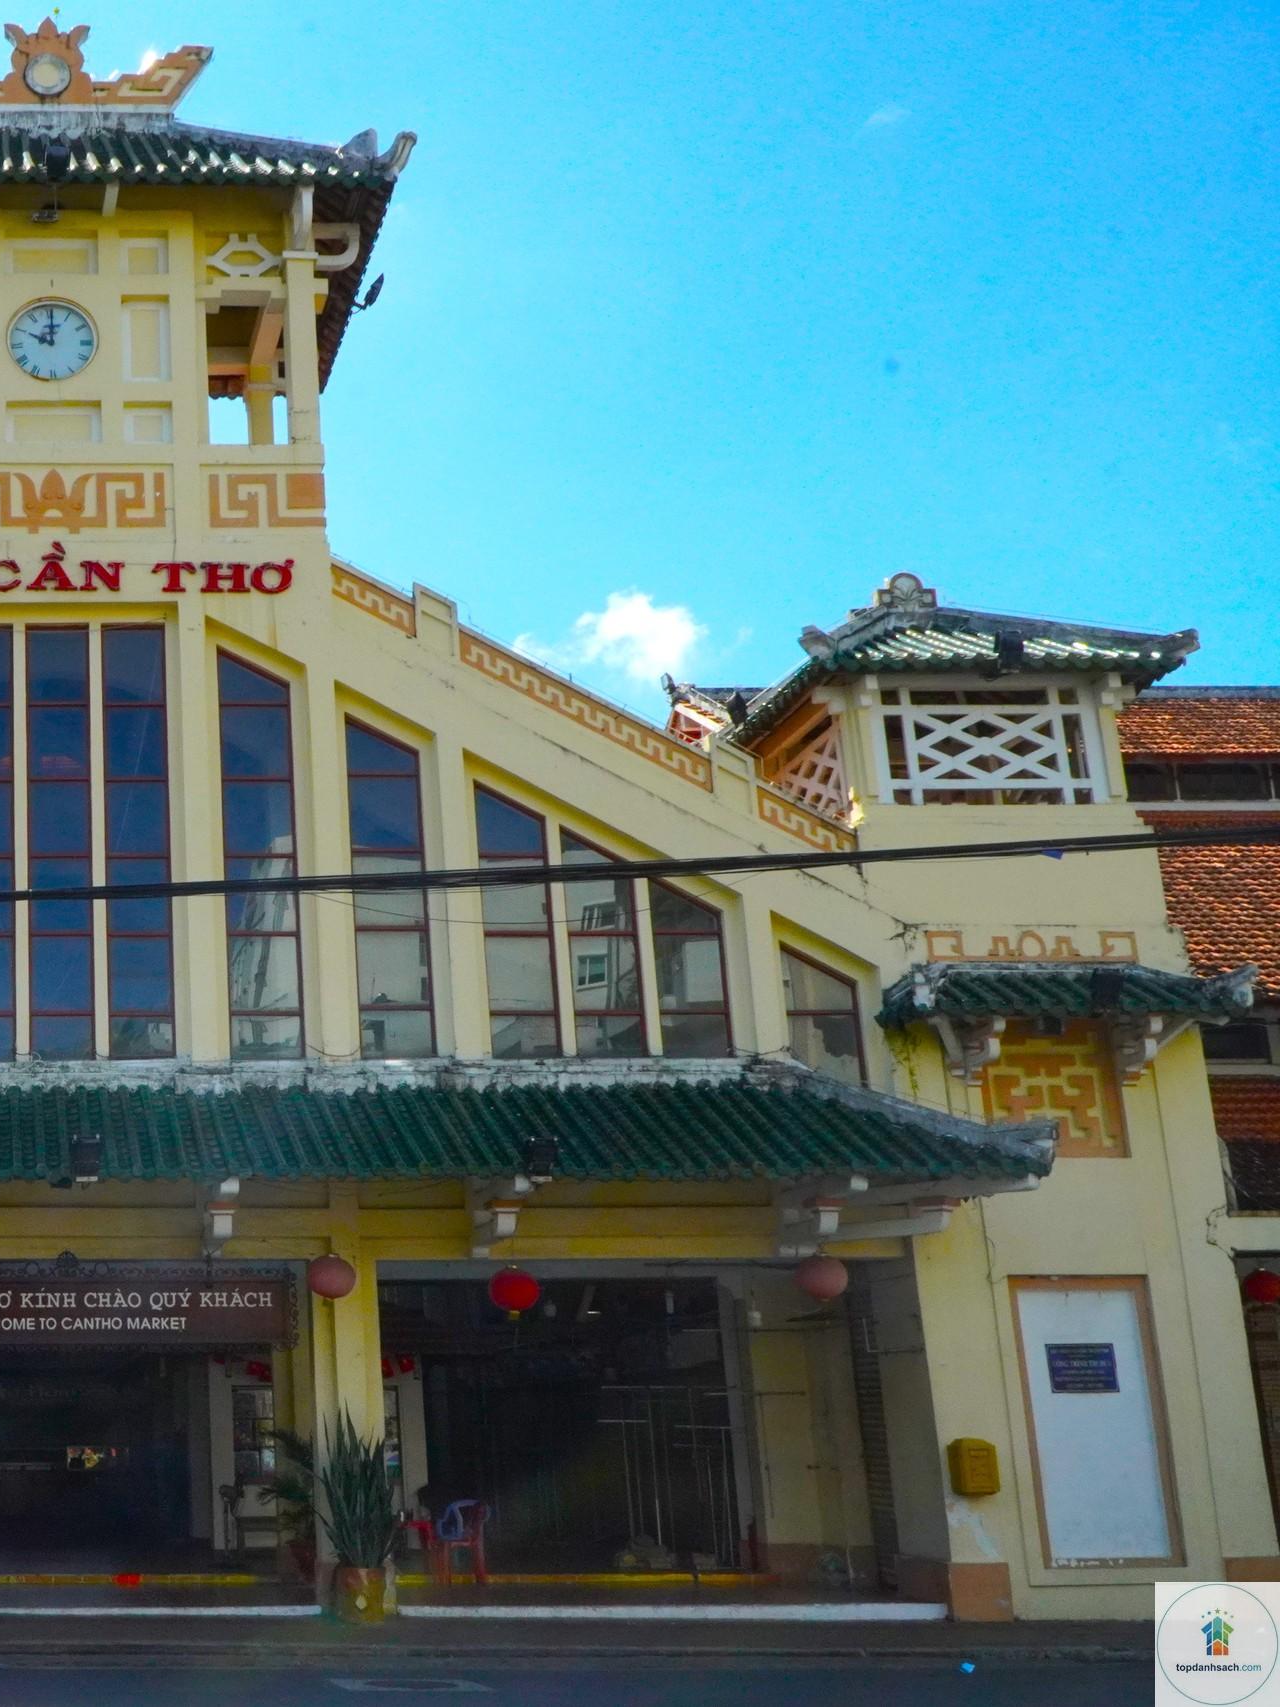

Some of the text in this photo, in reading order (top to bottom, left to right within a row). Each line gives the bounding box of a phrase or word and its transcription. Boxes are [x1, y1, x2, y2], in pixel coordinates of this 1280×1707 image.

[151, 558, 295, 593] THƠ
[20, 1287, 77, 1309] KÍNH
[83, 1289, 142, 1309] CHÀO
[149, 1288, 192, 1311] QUÝ
[199, 1288, 273, 1308] KHÁCH
[39, 1317, 57, 1331] TO
[61, 1317, 123, 1331] CANTHO
[127, 1317, 187, 1331] MARKET
